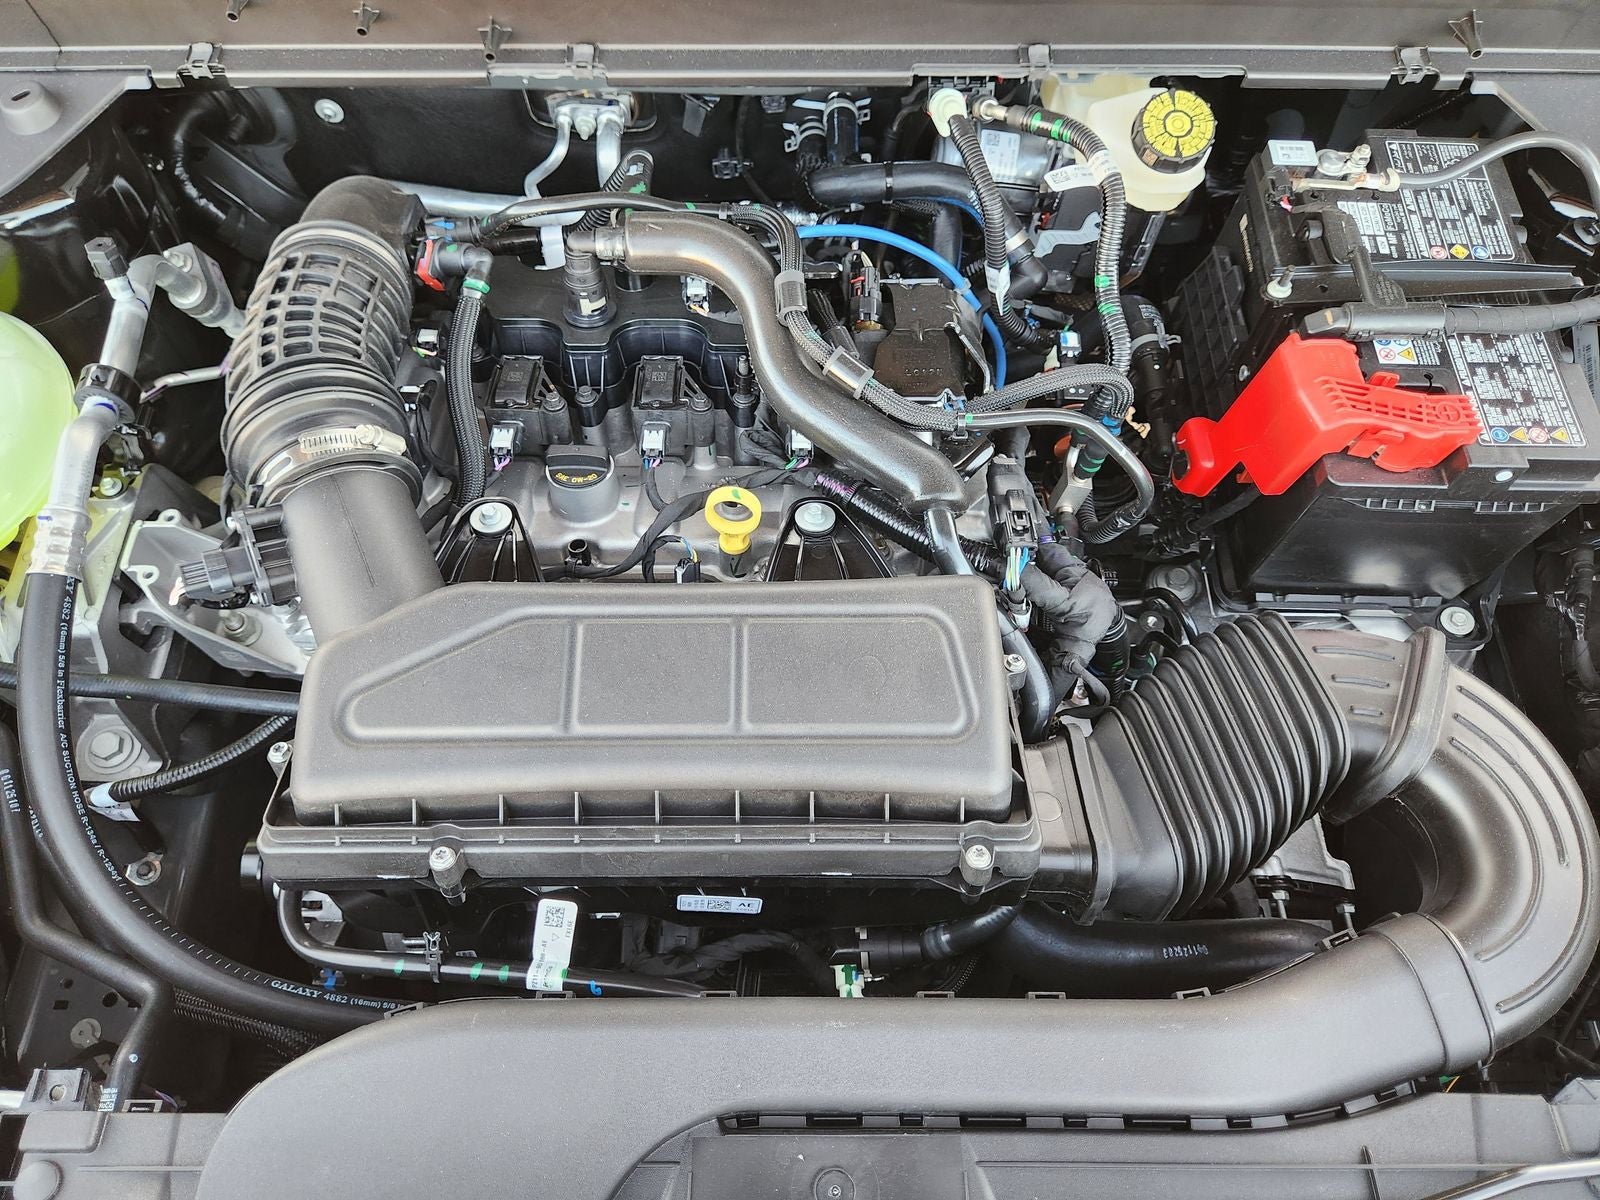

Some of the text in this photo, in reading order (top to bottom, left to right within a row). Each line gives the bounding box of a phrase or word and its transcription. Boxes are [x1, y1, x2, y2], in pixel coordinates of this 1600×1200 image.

[1381, 203, 1394, 229] FoMoCo
[556, 472, 598, 483] SAE 0W-20
[61, 596, 72, 620] 4882
[58, 623, 69, 653] (16mm)
[56, 680, 65, 730] Flexbarrier
[60, 733, 69, 748] A/C
[62, 750, 77, 792] SUCTION
[71, 791, 86, 816] HOSE
[80, 816, 98, 845] R-134a
[97, 849, 123, 882] R-1234yf
[271, 979, 322, 999] GALAXY
[323, 994, 348, 1004] 4882
[350, 997, 381, 1009] (16mm)
